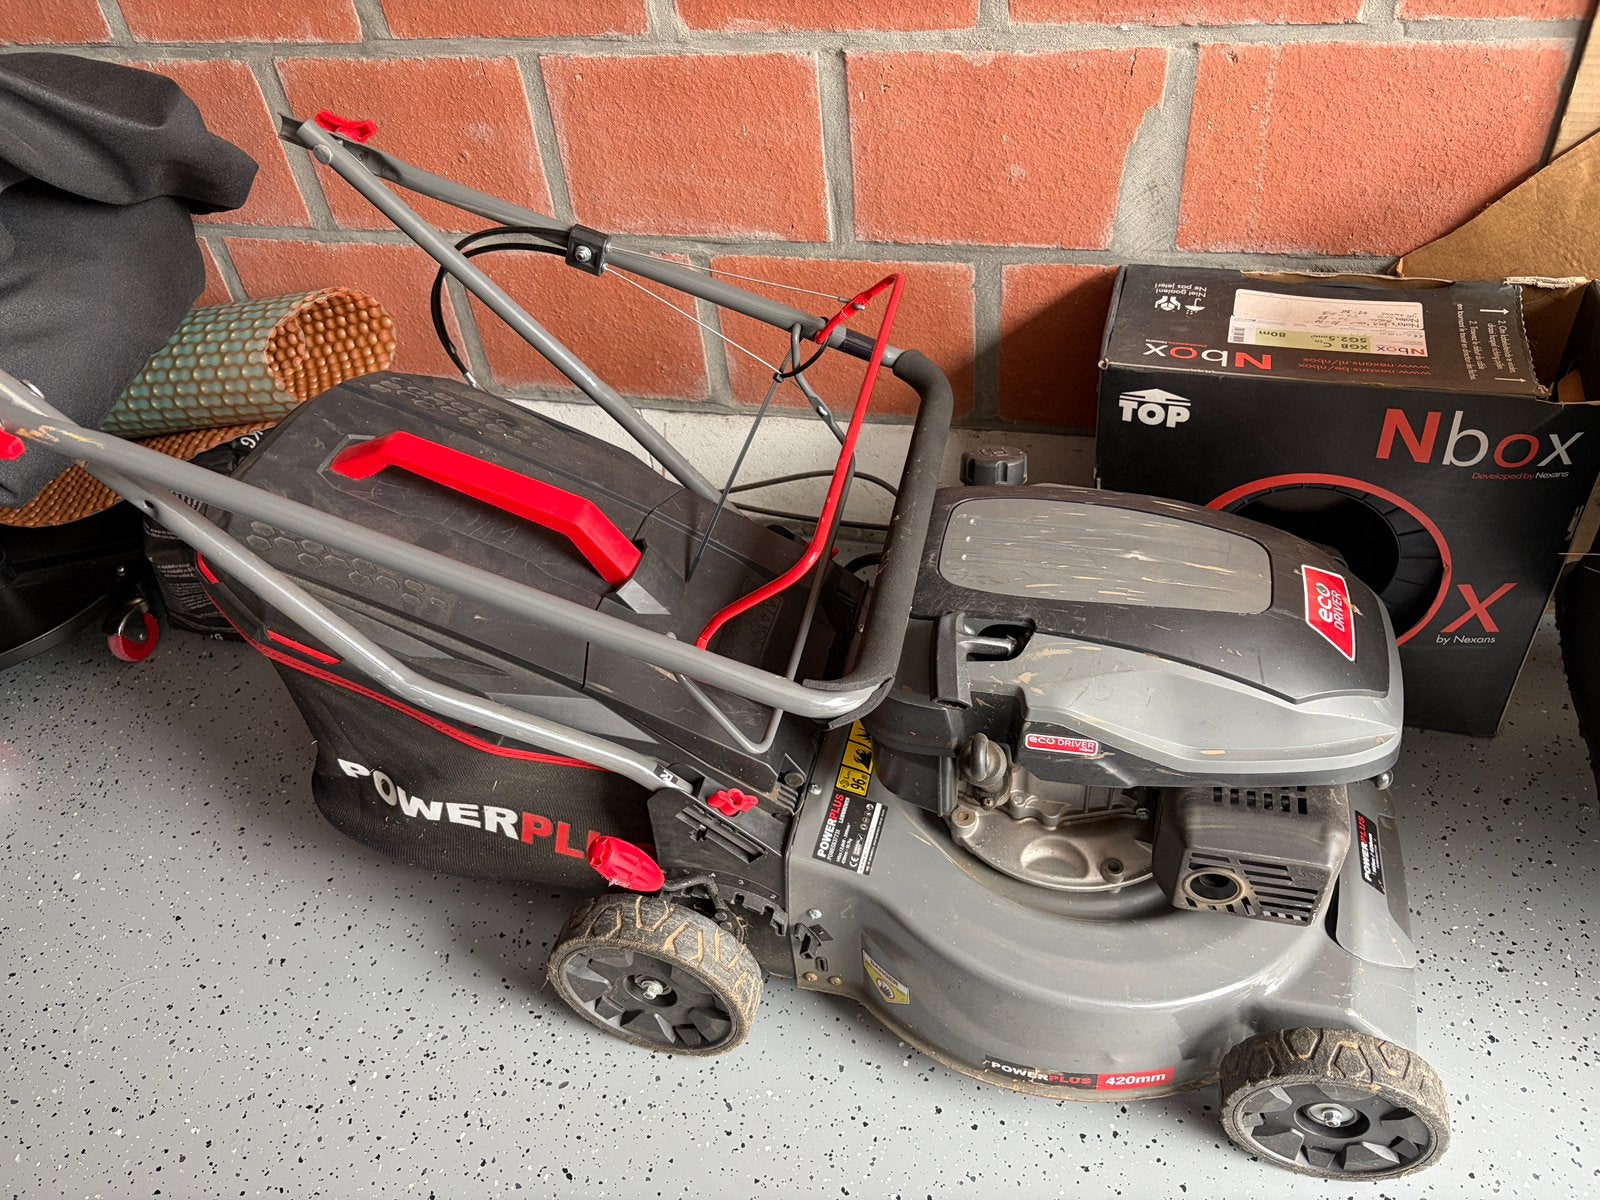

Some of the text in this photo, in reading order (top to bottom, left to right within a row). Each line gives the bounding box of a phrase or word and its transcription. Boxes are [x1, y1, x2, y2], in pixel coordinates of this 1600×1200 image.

[1457, 310, 1465, 328] tournant
[1259, 330, 1286, 338] 80m
[1143, 343, 1272, 370] Nbox
[1376, 344, 1425, 355] Nbox
[1298, 362, 1431, 375] www.nexans.be/nbox
[1302, 357, 1430, 369] www.nexans.nl/nbox
[1118, 399, 1191, 429] TOP
[1375, 408, 1585, 468] Nbox
[1471, 471, 1569, 482] Developed by Nexans
[1316, 582, 1333, 623] eco
[1331, 589, 1346, 632] DRIVER
[1435, 634, 1496, 645] by Nexans
[1028, 736, 1095, 749] eco DRIVER
[850, 777, 865, 791] 96
[337, 758, 601, 860] POWERPL
[838, 797, 850, 824] LAWNMOWER
[816, 793, 845, 858] POWERPLUS
[1357, 816, 1373, 882] POWERPLUS
[849, 856, 859, 868] CE
[991, 1061, 1093, 1085] POWERPLUS
[1105, 1072, 1167, 1086] 420mm
